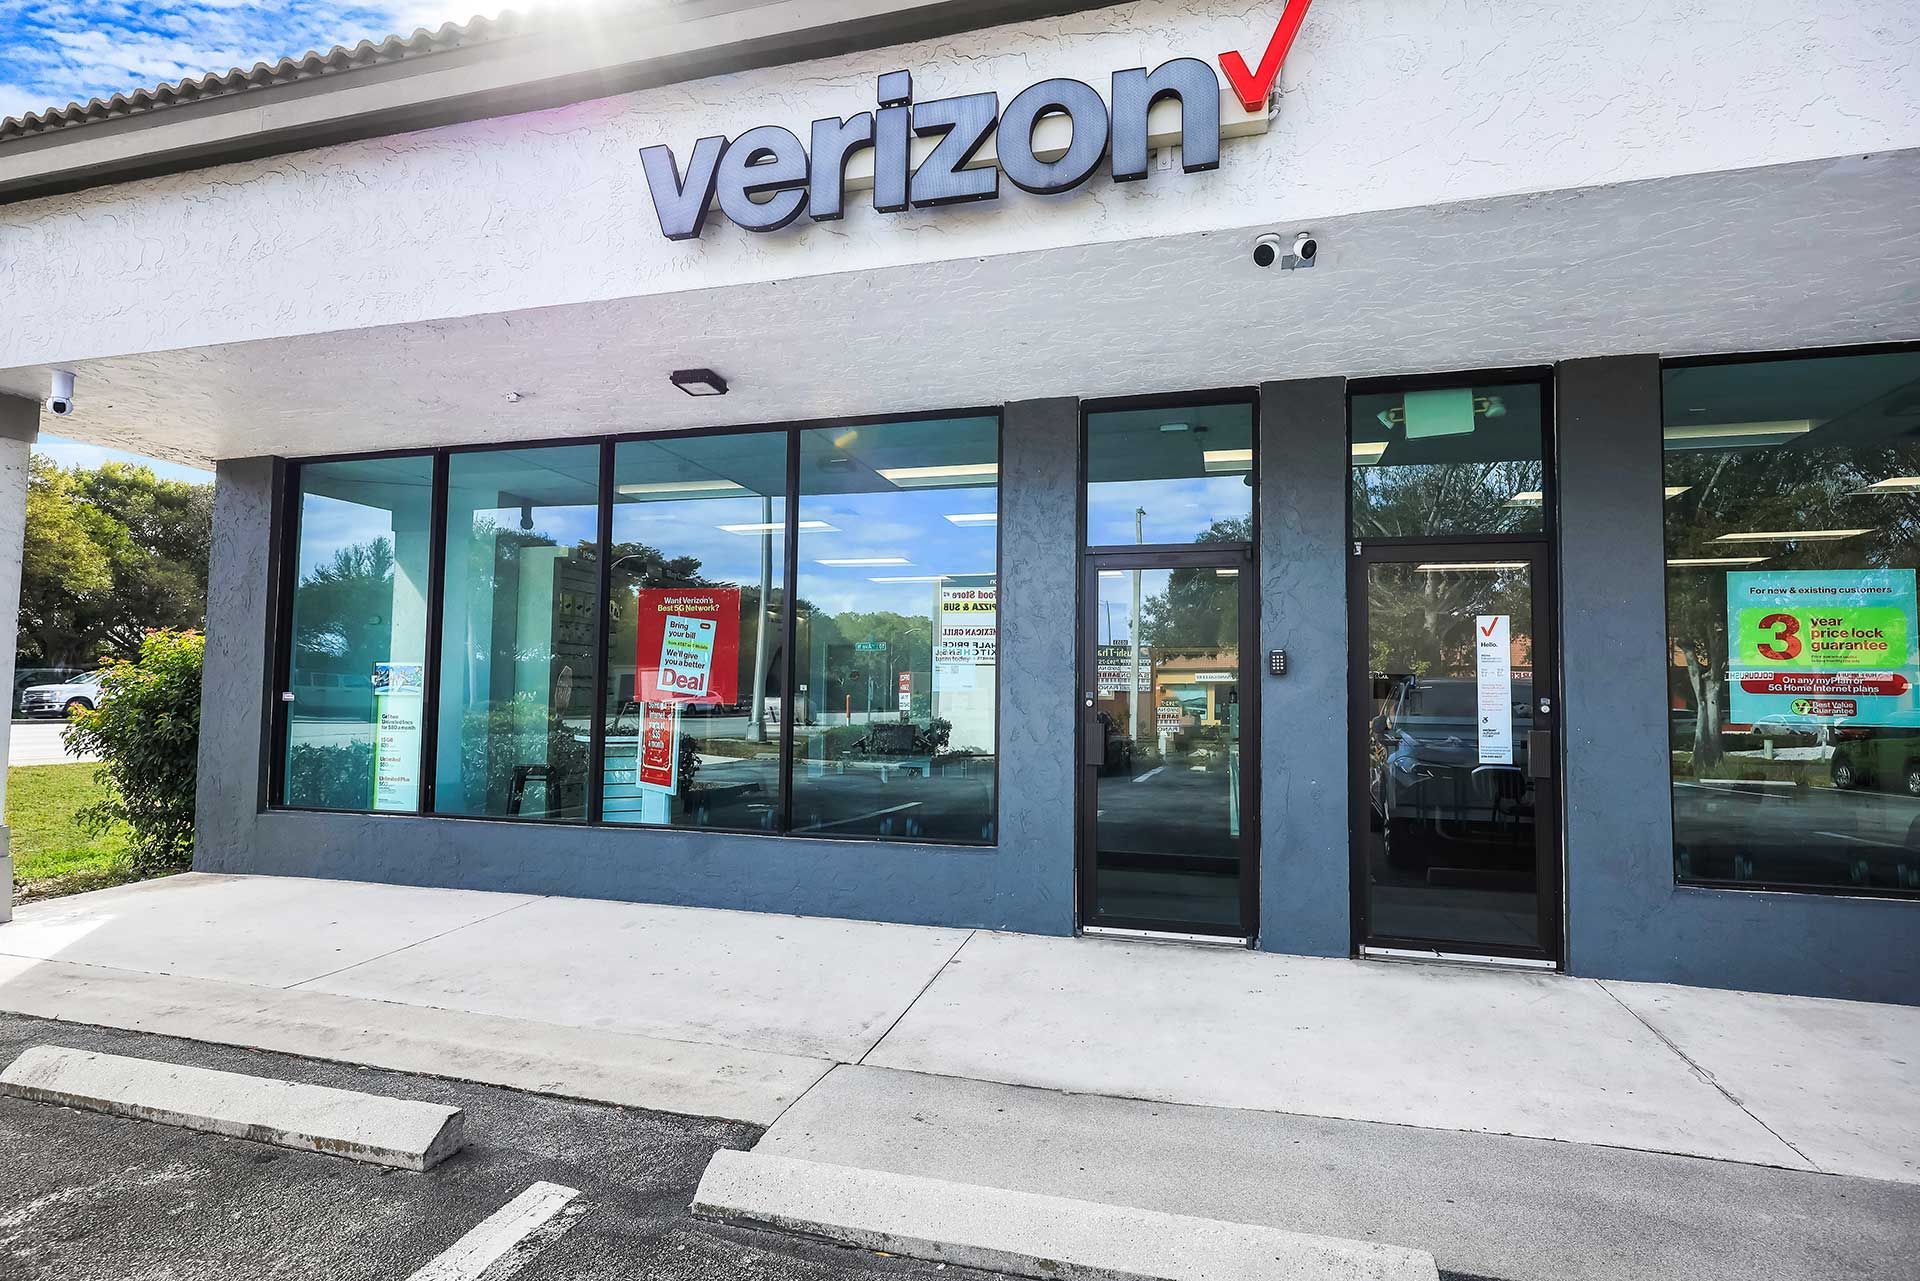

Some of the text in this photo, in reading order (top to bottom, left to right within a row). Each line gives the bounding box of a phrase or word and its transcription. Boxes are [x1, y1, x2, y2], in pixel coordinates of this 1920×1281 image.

[639, 57, 1220, 241] verizon
[1798, 586, 1837, 596] existing
[1839, 586, 1893, 594] customers
[682, 596, 714, 604] Verizon's
[674, 604, 685, 612] 5G
[685, 604, 720, 612] Network?
[670, 621, 689, 631] Bring
[1811, 616, 1844, 628] year
[1757, 613, 1803, 661] 3
[1811, 628, 1884, 640] price lock
[1811, 640, 1889, 652] guarantee
[666, 649, 698, 660] We'll give
[664, 658, 678, 666] you
[683, 660, 706, 670] better
[661, 668, 706, 691] Deal
[1782, 676, 1797, 684] On
[1798, 678, 1815, 686] any
[1816, 677, 1852, 686] myPlan
[1784, 684, 1812, 692] Home
[1814, 684, 1852, 692] Internet
